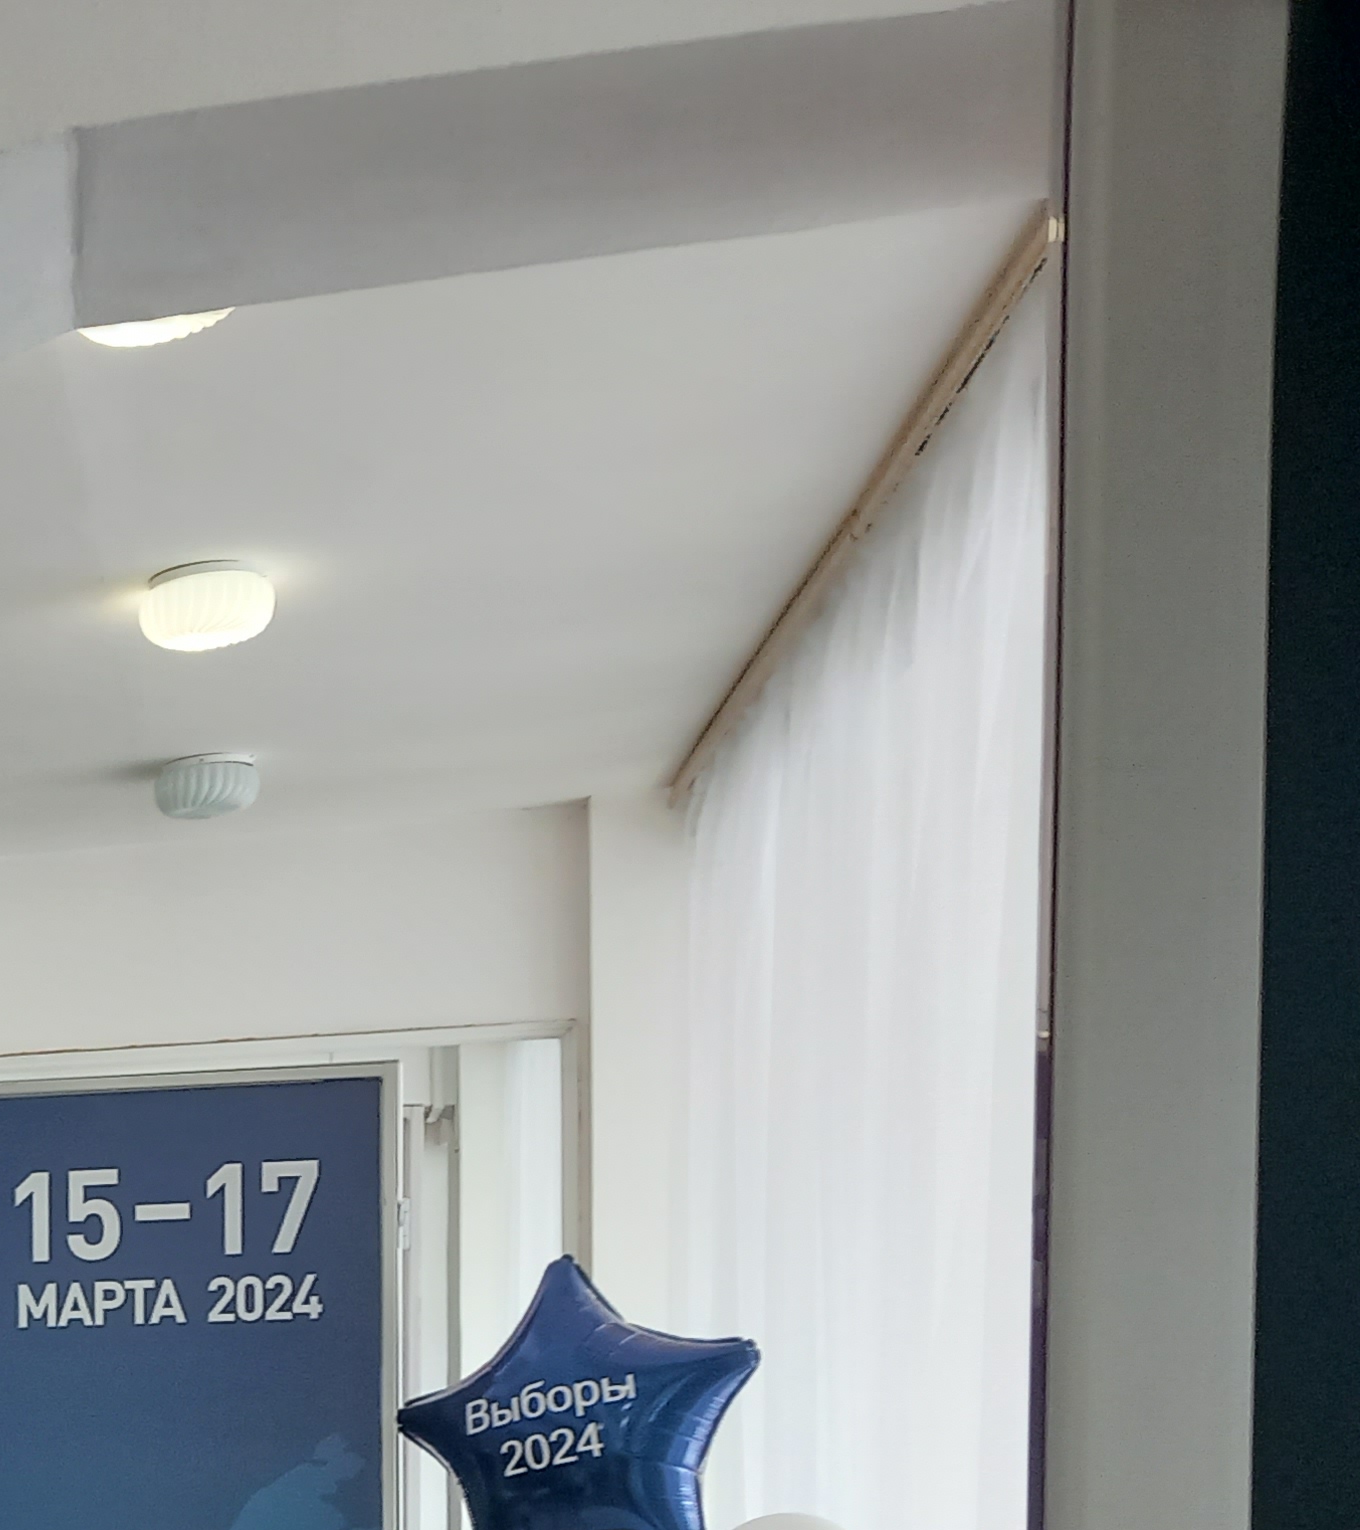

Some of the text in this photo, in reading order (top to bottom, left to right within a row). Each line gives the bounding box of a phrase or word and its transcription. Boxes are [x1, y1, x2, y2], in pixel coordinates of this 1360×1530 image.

[16, 1272, 324, 1329] МАРТА 2024
[464, 1372, 637, 1436] Выборы
[499, 1422, 605, 1478] 2024
